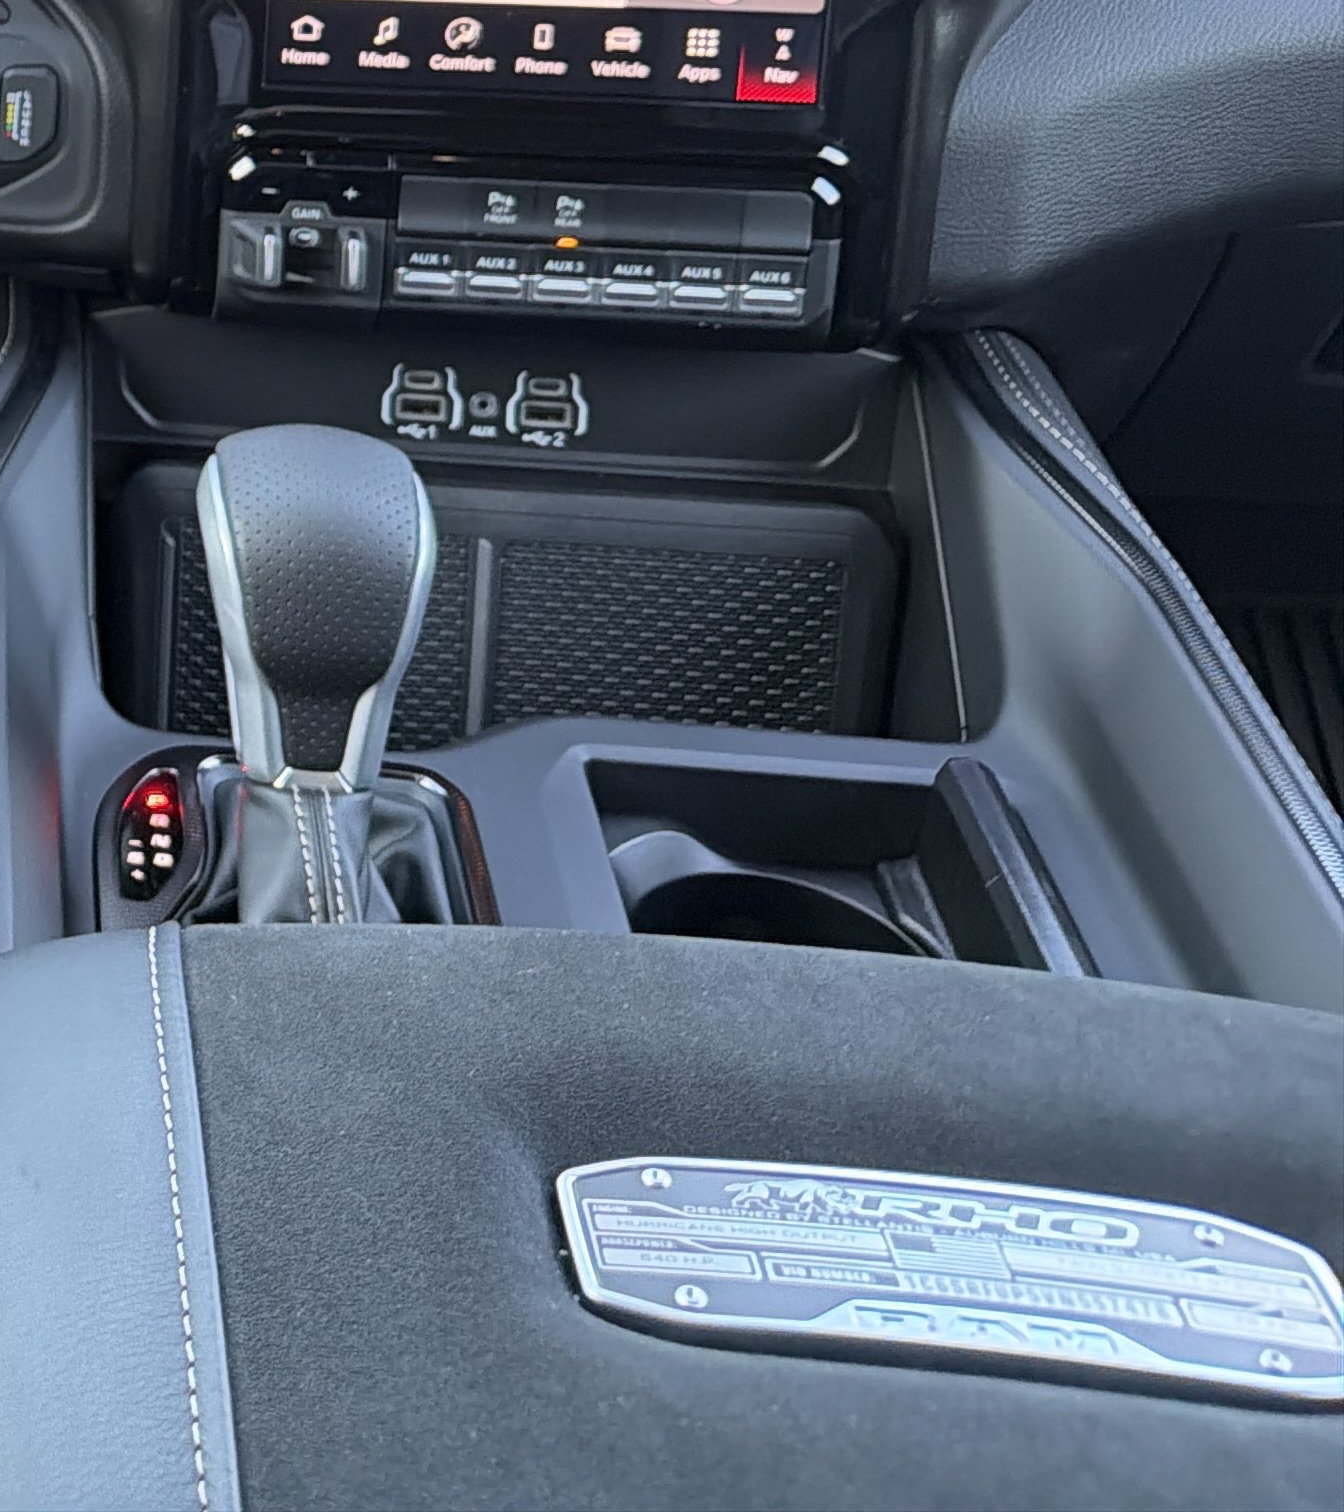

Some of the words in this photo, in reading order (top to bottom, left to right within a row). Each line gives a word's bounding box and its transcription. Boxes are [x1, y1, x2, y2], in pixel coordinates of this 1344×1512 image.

[280, 47, 331, 66] Home
[358, 49, 410, 70] Media
[428, 53, 497, 73] Comfort
[514, 56, 568, 76] Phone
[591, 59, 652, 80] Vehicle
[678, 63, 722, 84] Apps
[762, 66, 800, 85] Nav
[290, 206, 322, 221] GAIN
[467, 424, 498, 438] AUX
[683, 1204, 781, 1220] DESIGNED
[639, 1253, 679, 1264] 540
